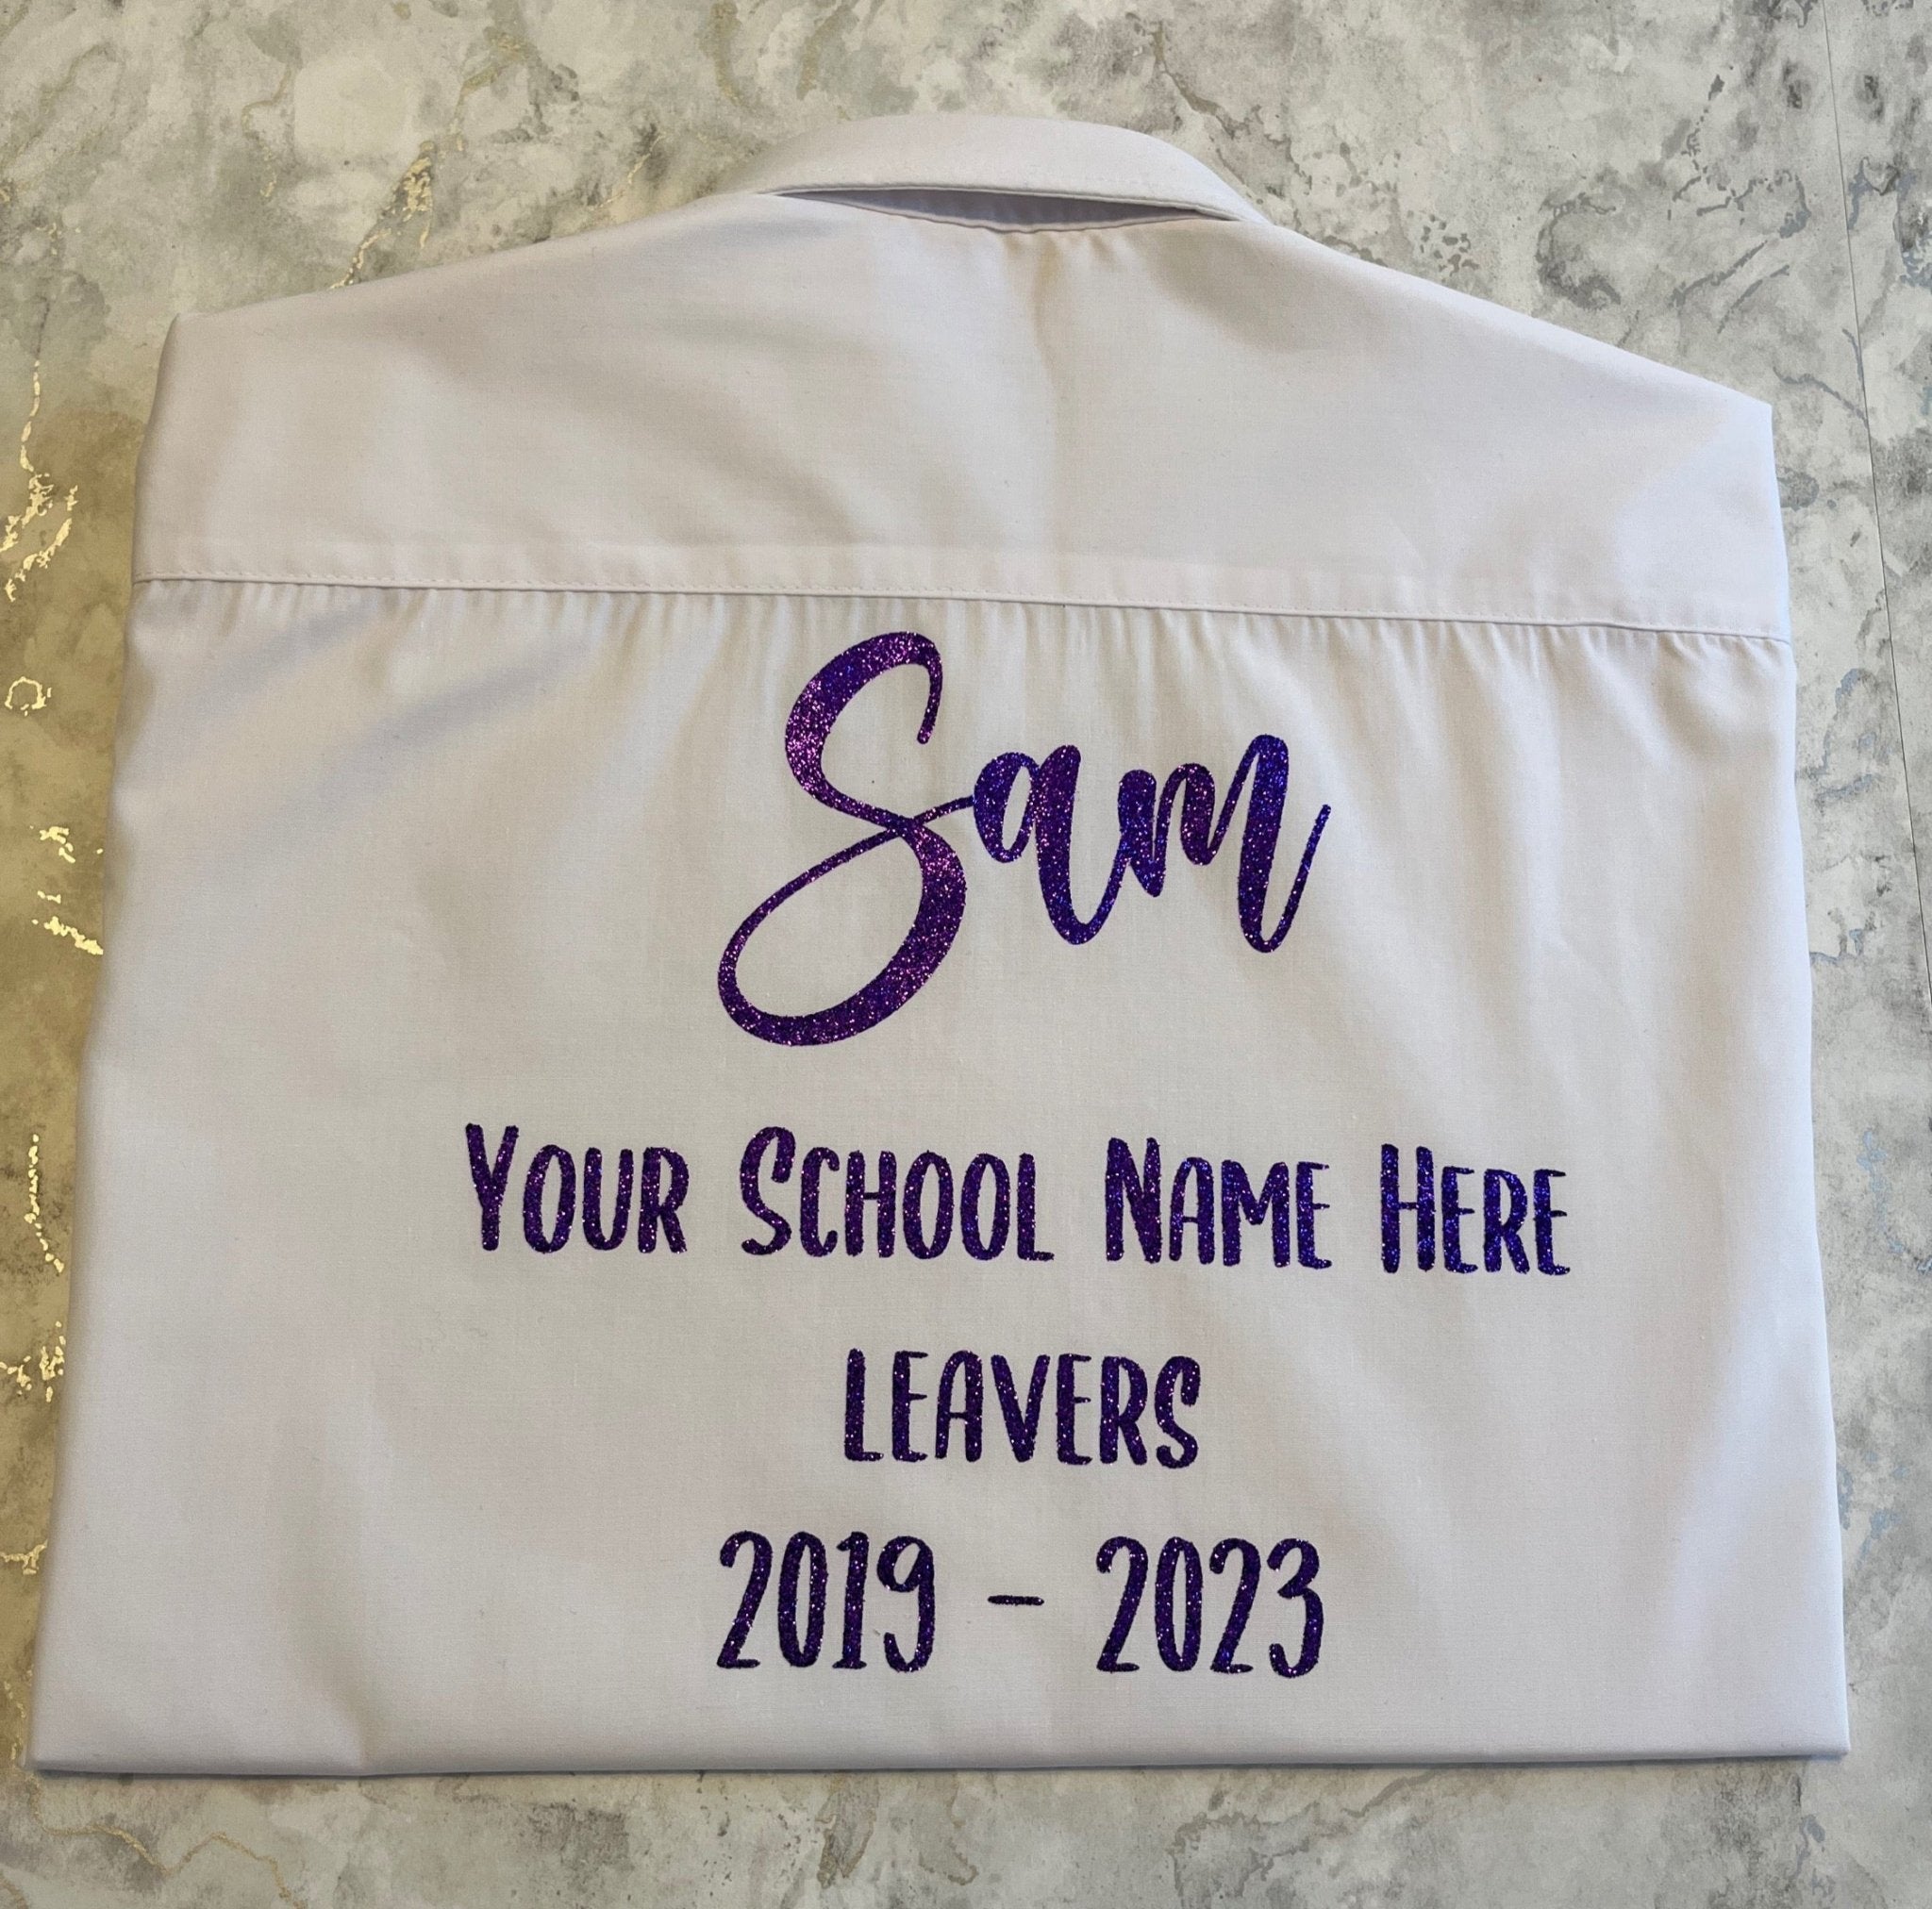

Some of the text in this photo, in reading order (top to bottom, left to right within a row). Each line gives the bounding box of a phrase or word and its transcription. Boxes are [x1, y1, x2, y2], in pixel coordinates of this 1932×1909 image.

[718, 631, 1332, 1047] Sam
[843, 1348, 1202, 1469] LEAVERS
[716, 1530, 936, 1673] 2019
[1095, 1536, 1324, 1680] 2023
